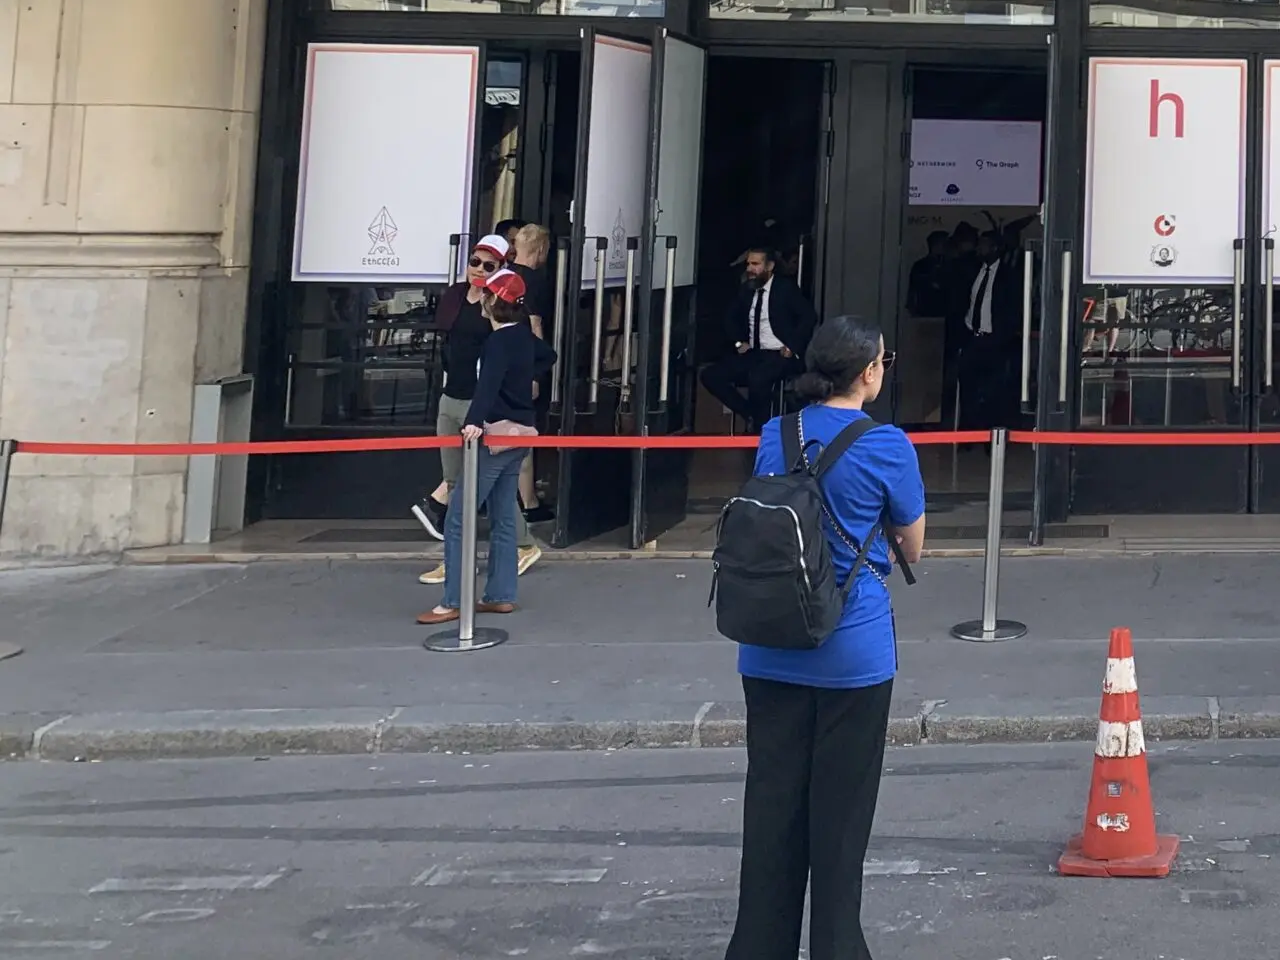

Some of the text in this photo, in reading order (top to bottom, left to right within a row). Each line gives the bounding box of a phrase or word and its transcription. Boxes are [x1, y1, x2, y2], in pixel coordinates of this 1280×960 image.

[1149, 79, 1184, 138] h
[999, 161, 1020, 169] Graph
[361, 257, 400, 266] EthCC[6]
